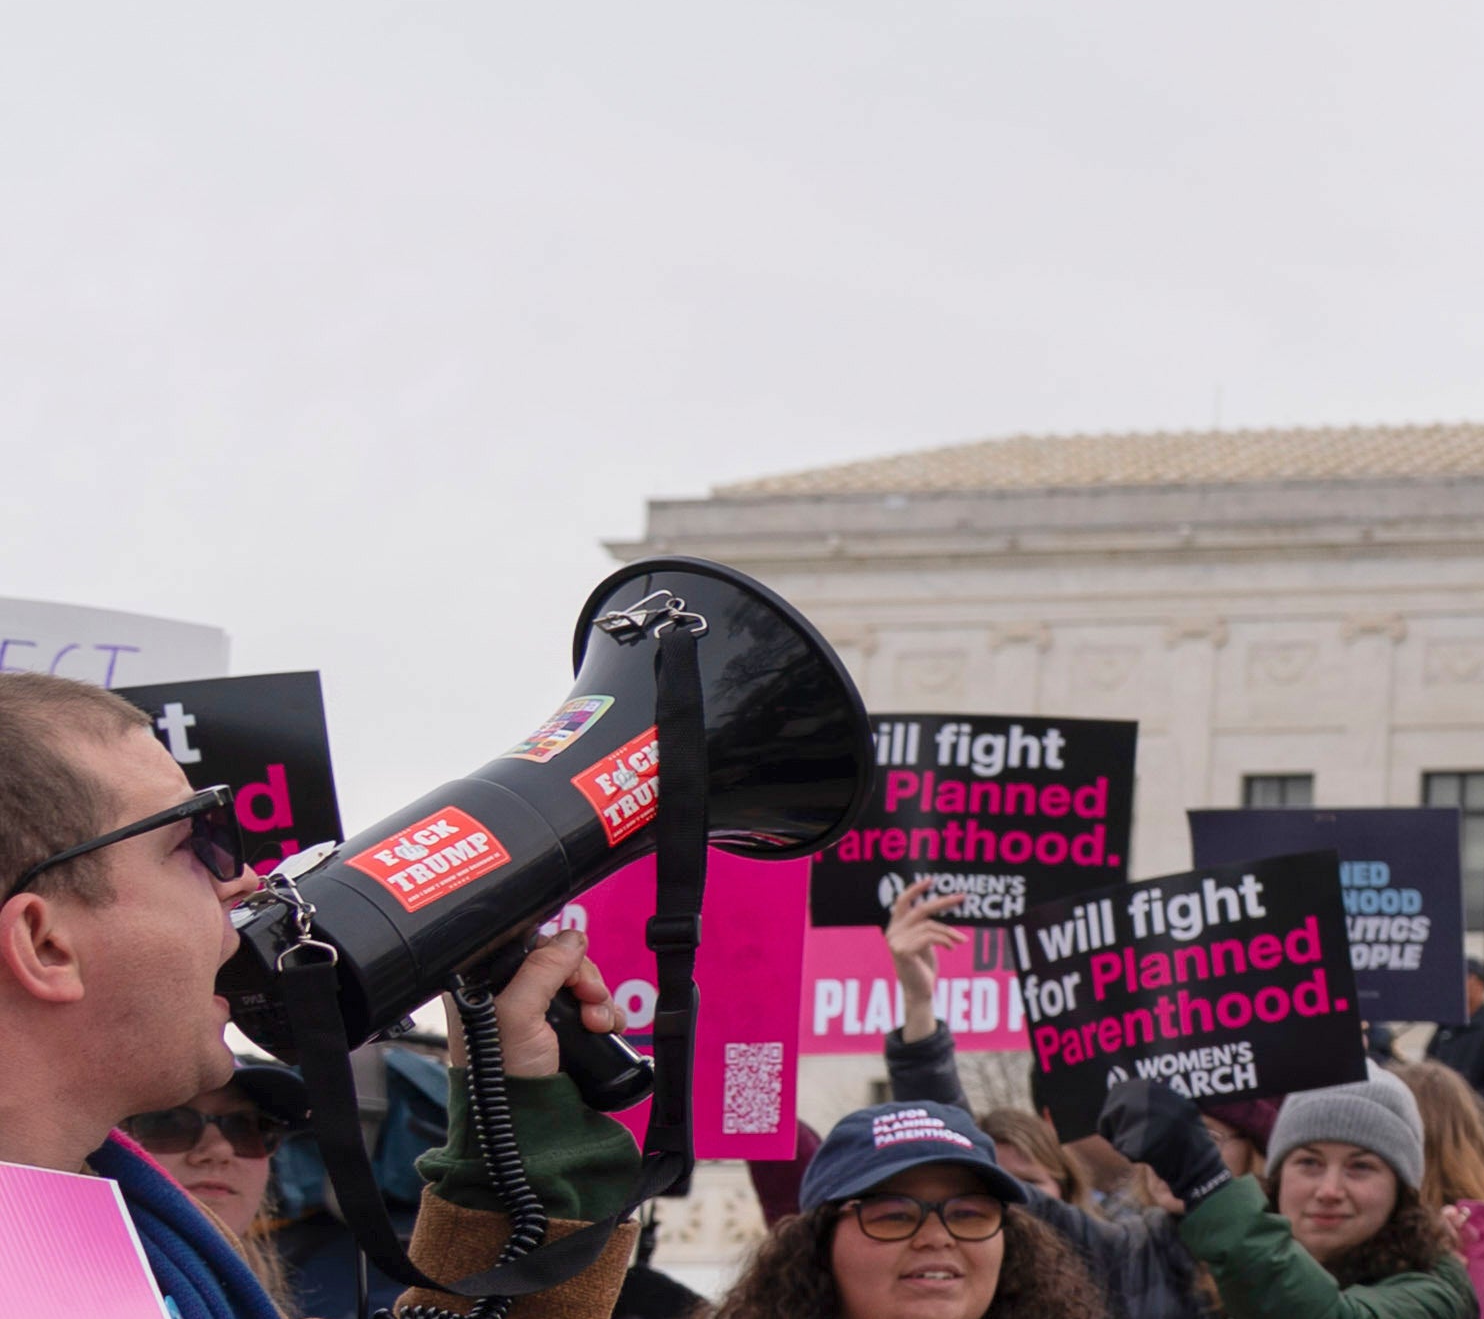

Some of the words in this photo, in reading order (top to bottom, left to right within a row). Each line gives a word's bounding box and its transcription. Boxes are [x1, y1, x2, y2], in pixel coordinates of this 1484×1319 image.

[935, 722, 1066, 777] fight
[603, 776, 659, 827] TRU
[884, 770, 1109, 819] Planned
[387, 833, 489, 893] TRUMP
[814, 819, 1122, 868] arenthood.
[914, 892, 1026, 920] ARCH
[1014, 924, 1032, 972] I
[1037, 898, 1117, 963] will
[1127, 874, 1267, 941] fight
[1023, 971, 1082, 1023] for
[1090, 915, 1322, 1001] Planned
[1351, 943, 1423, 970] OPLE
[1033, 967, 1349, 1073] Parenthood.
[1135, 1041, 1254, 1080] WOMEN'S
[1157, 1062, 1258, 1099] ARCH
[873, 1117, 945, 1133] PLANNED
[874, 1127, 973, 1147] PARENTHOOD
